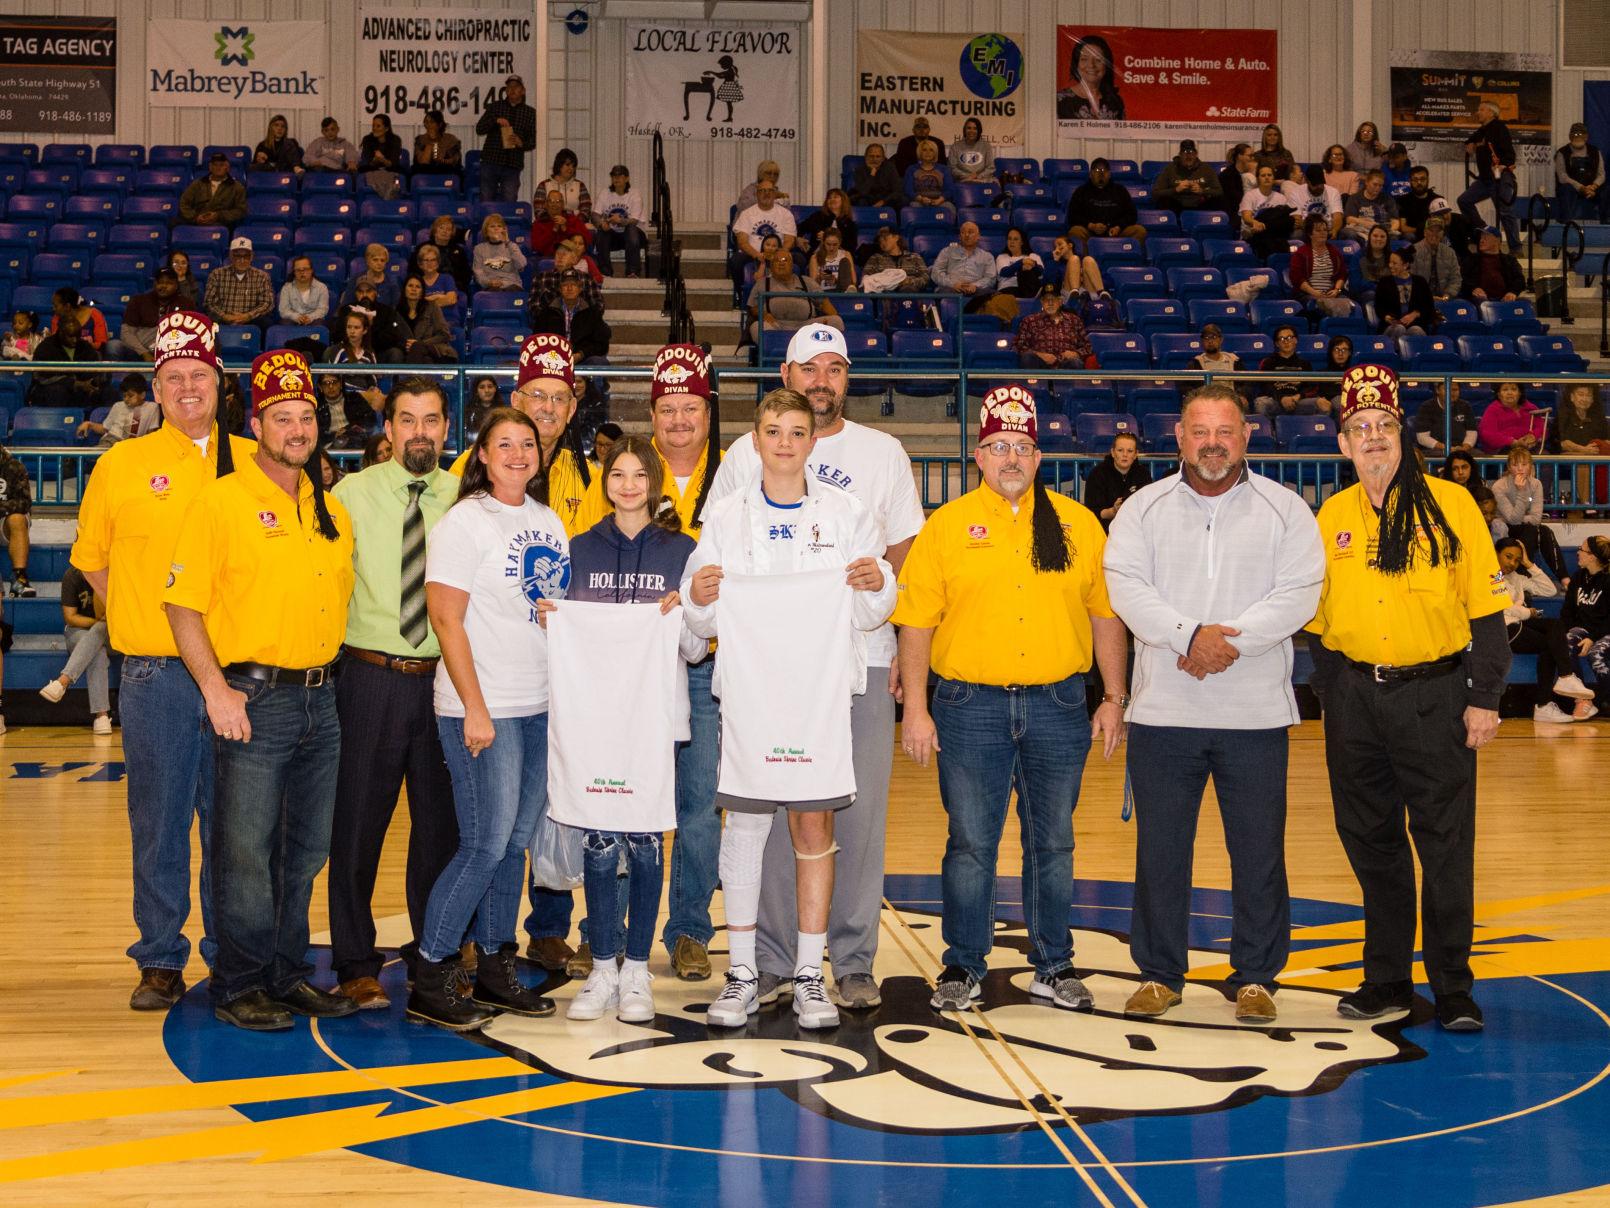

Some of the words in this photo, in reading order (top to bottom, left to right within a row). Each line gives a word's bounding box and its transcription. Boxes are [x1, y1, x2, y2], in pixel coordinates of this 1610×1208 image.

[363, 17, 432, 41] ADVANCED
[435, 18, 530, 42] CHIROPRACTIC
[3, 37, 38, 55] TAG
[42, 38, 114, 57] AGENCY
[633, 28, 702, 53] LOCAL
[706, 30, 792, 55] FLAVOR
[379, 49, 459, 74] NEUROLOGY
[463, 51, 514, 74] CENTER
[1123, 55, 1181, 70] Combine
[1184, 57, 1221, 70] Home
[1225, 58, 1235, 70] &
[1238, 58, 1270, 71] Auto.
[18, 78, 43, 88] State
[46, 78, 87, 90] Highway
[89, 79, 101, 89] 51
[860, 72, 944, 92] EASTERN
[1123, 71, 1155, 84] Save
[1158, 72, 1169, 84] &
[1172, 72, 1211, 85] Smile.
[365, 85, 508, 115] 918-486-14
[860, 95, 1016, 116] MANUFACTURING
[39, 110, 112, 122] 918-486-1189
[710, 126, 796, 140] 918-482-4749
[1058, 120, 1079, 128] Karen
[1114, 122, 1161, 130] 918-486-2106
[1002, 134, 1017, 144] OK
[542, 368, 565, 377] DIVAN
[664, 386, 689, 394] DIVAN
[258, 391, 301, 410] TOURNAMENT
[1001, 423, 1029, 433] DIVAN
[589, 572, 666, 591] HOLLISTER
